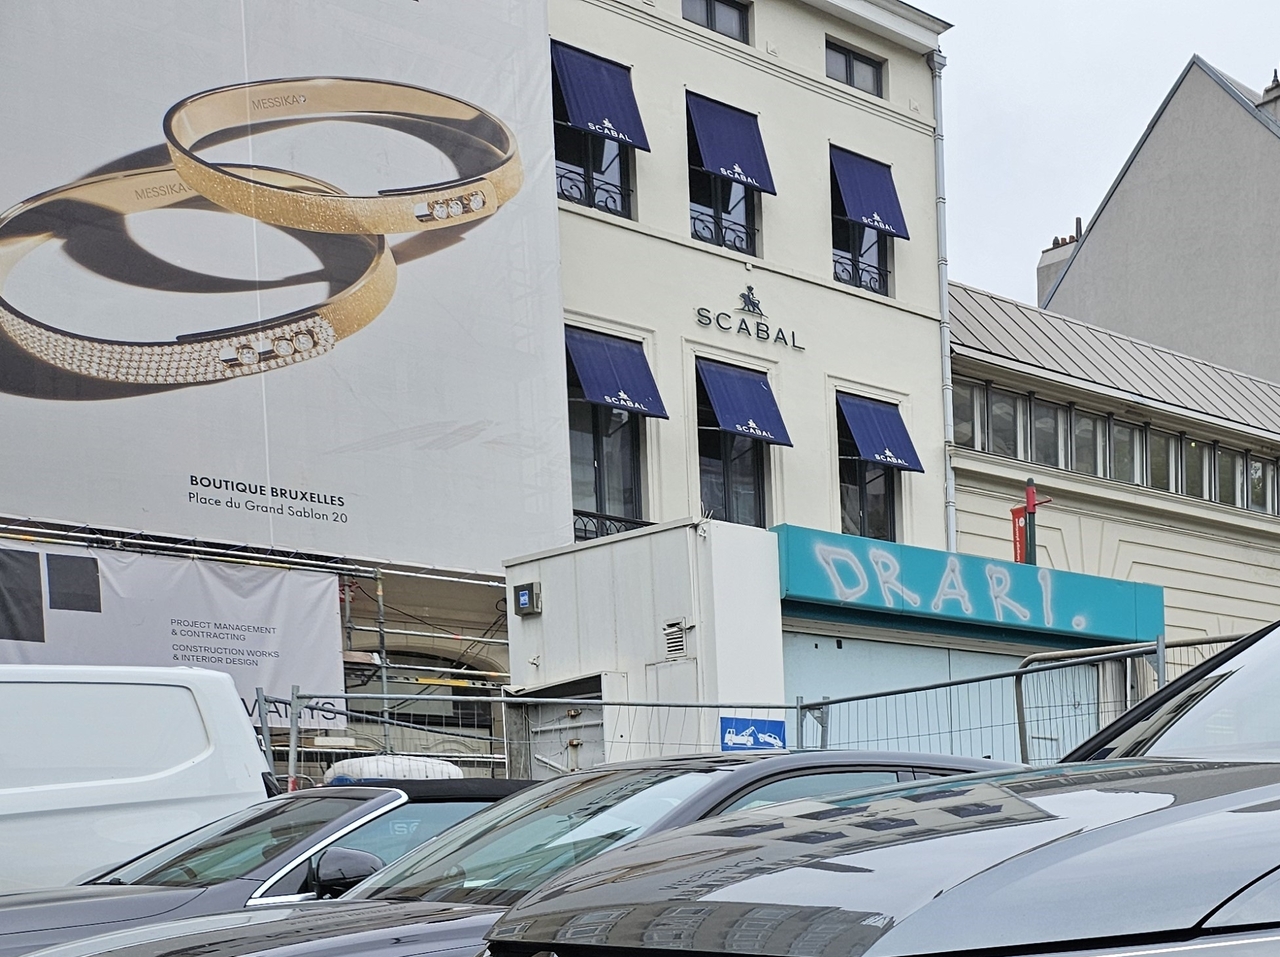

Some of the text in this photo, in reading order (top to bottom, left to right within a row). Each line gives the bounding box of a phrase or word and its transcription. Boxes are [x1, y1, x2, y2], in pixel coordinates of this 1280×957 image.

[252, 95, 300, 111] MESSIKA
[588, 122, 632, 142] SCABAL
[720, 167, 760, 187] SCABAL
[134, 182, 187, 200] MESSIKA
[862, 216, 896, 232] SCABAL
[697, 307, 805, 350] SCABAL
[604, 395, 648, 410] SCABAL
[735, 424, 774, 439] SCABAL
[874, 453, 909, 466] SCABAL
[190, 475, 345, 507] BOUTIQUE BRUXELLES
[188, 491, 348, 523] Place du Grand Sablon 20
[170, 618, 277, 634] PROJECT MANAGEMENT
[171, 628, 246, 641] & CONTRACTING
[172, 643, 280, 658] CONSTRUCTION WORKS
[172, 653, 259, 666] & INTERIOR DESIGN
